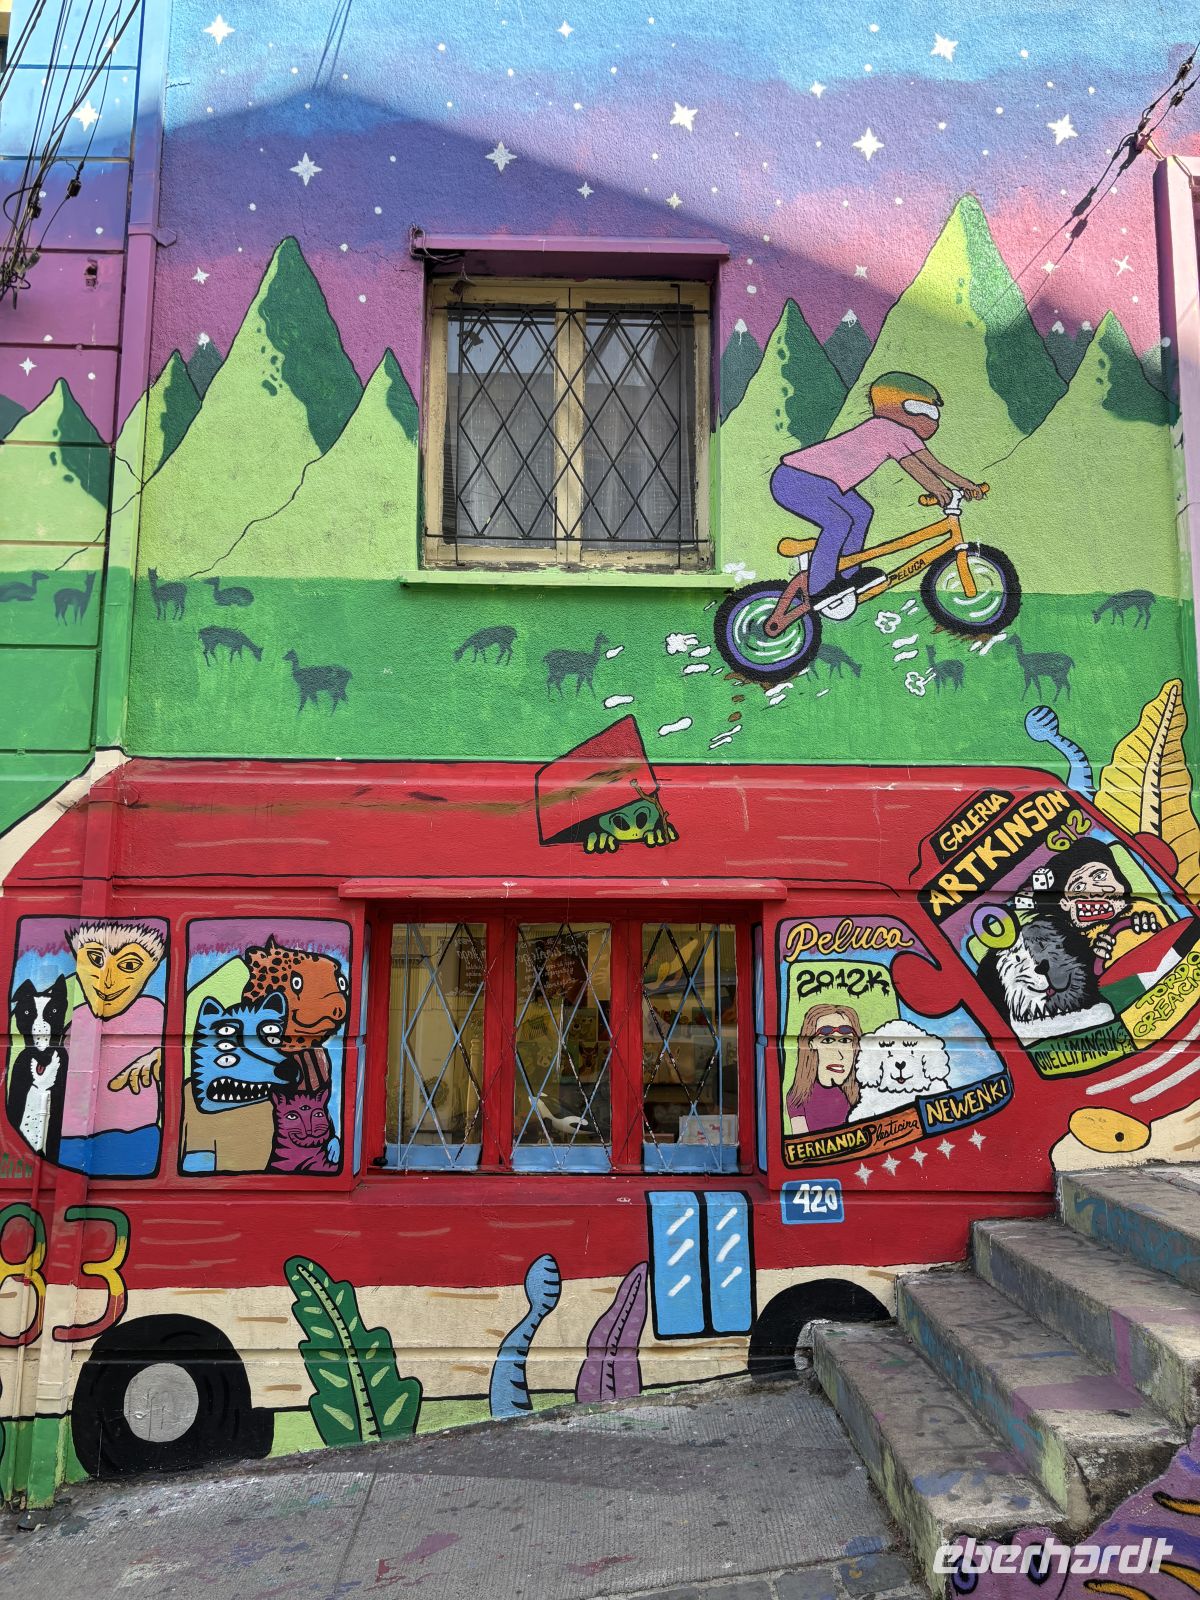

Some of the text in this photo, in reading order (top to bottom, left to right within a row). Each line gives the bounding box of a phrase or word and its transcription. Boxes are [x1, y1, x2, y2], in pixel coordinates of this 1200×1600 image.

[888, 557, 927, 585] PELUCA
[939, 793, 1010, 852] GALERIA
[1046, 808, 1092, 852] 612
[929, 790, 1071, 917] ARTKINSON
[783, 918, 915, 963] Peluca
[1135, 951, 1200, 1009] TORDO
[925, 1081, 1008, 1127] NEWENKI
[787, 1134, 868, 1162] FERNANDA
[793, 1183, 839, 1214] 420
